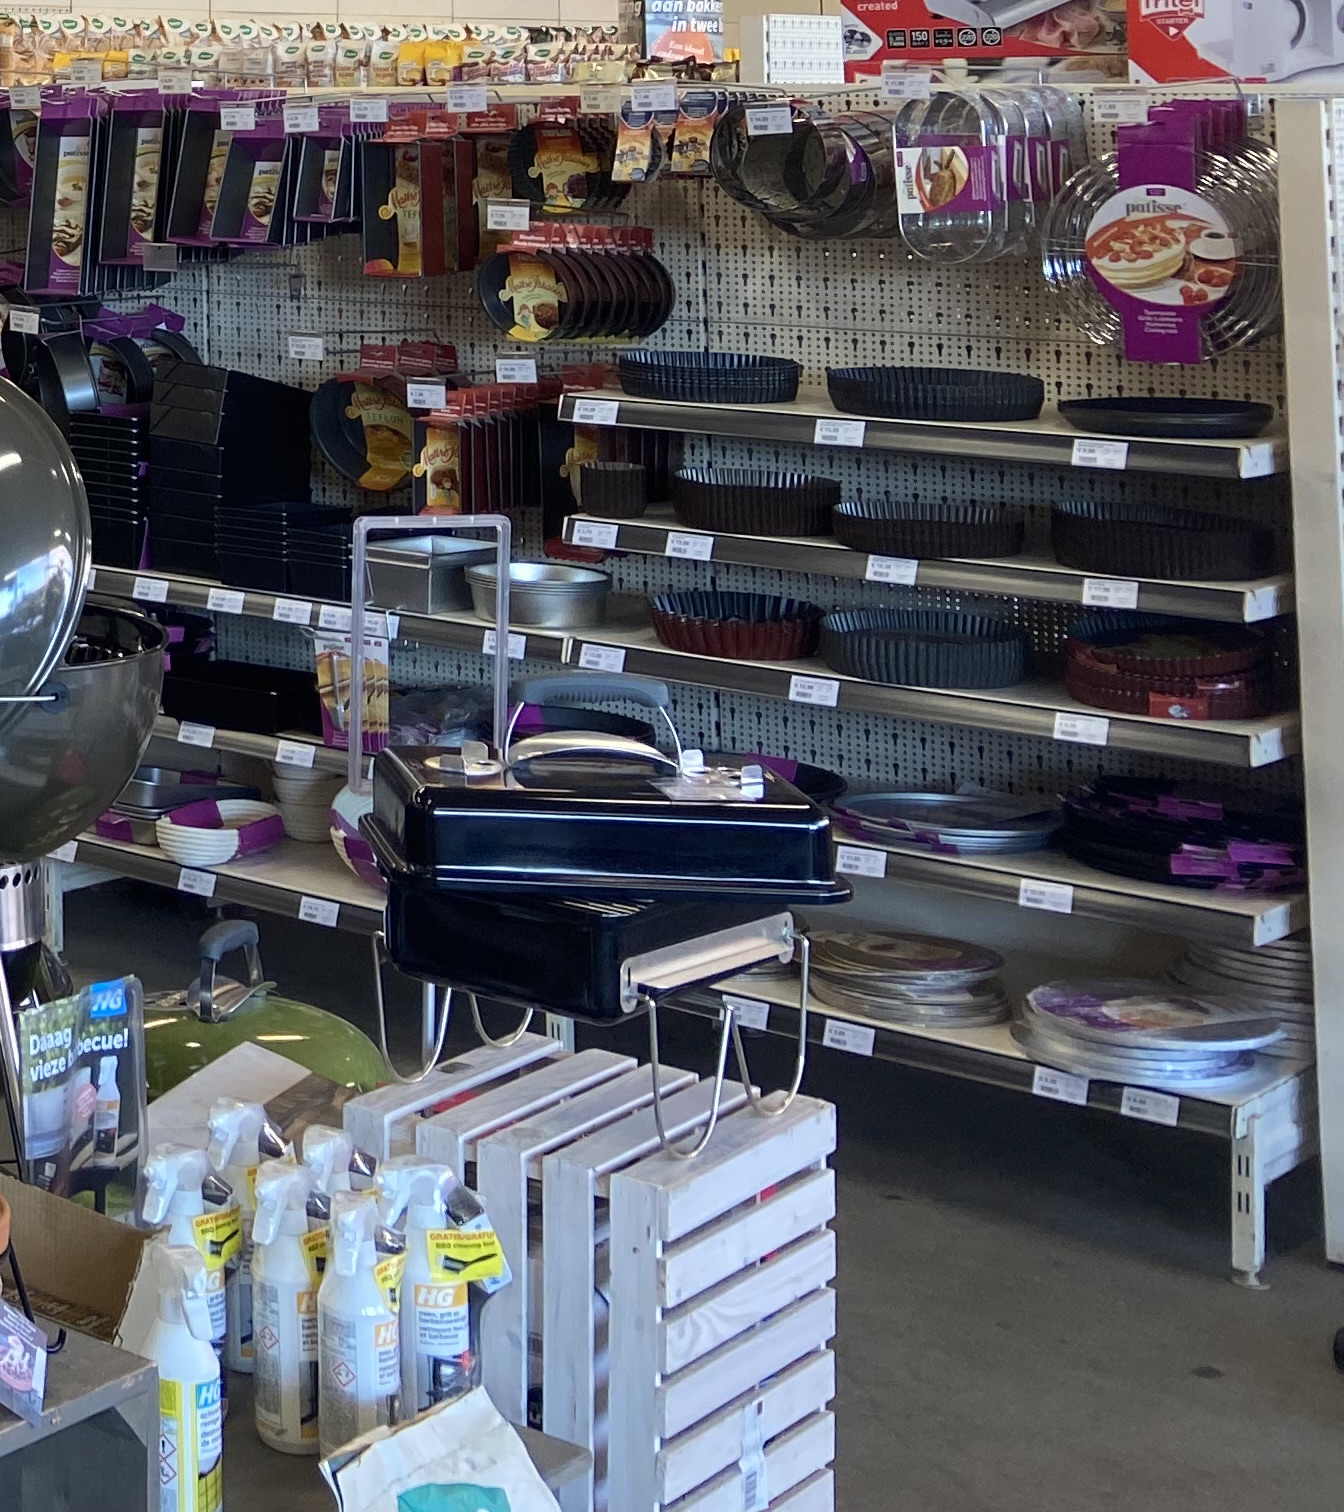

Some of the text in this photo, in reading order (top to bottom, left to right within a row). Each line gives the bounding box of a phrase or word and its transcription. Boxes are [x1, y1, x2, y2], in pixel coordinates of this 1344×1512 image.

[651, 0, 684, 13] aan
[857, 0, 899, 12] created
[672, 15, 687, 33] in
[911, 31, 928, 42] 150
[1125, 199, 1183, 217] patisse
[365, 412, 405, 424] TEFLON
[93, 988, 123, 1012] HG
[29, 1027, 72, 1056] Daaag
[30, 1056, 67, 1082] vieze
[417, 1287, 455, 1306] HG
